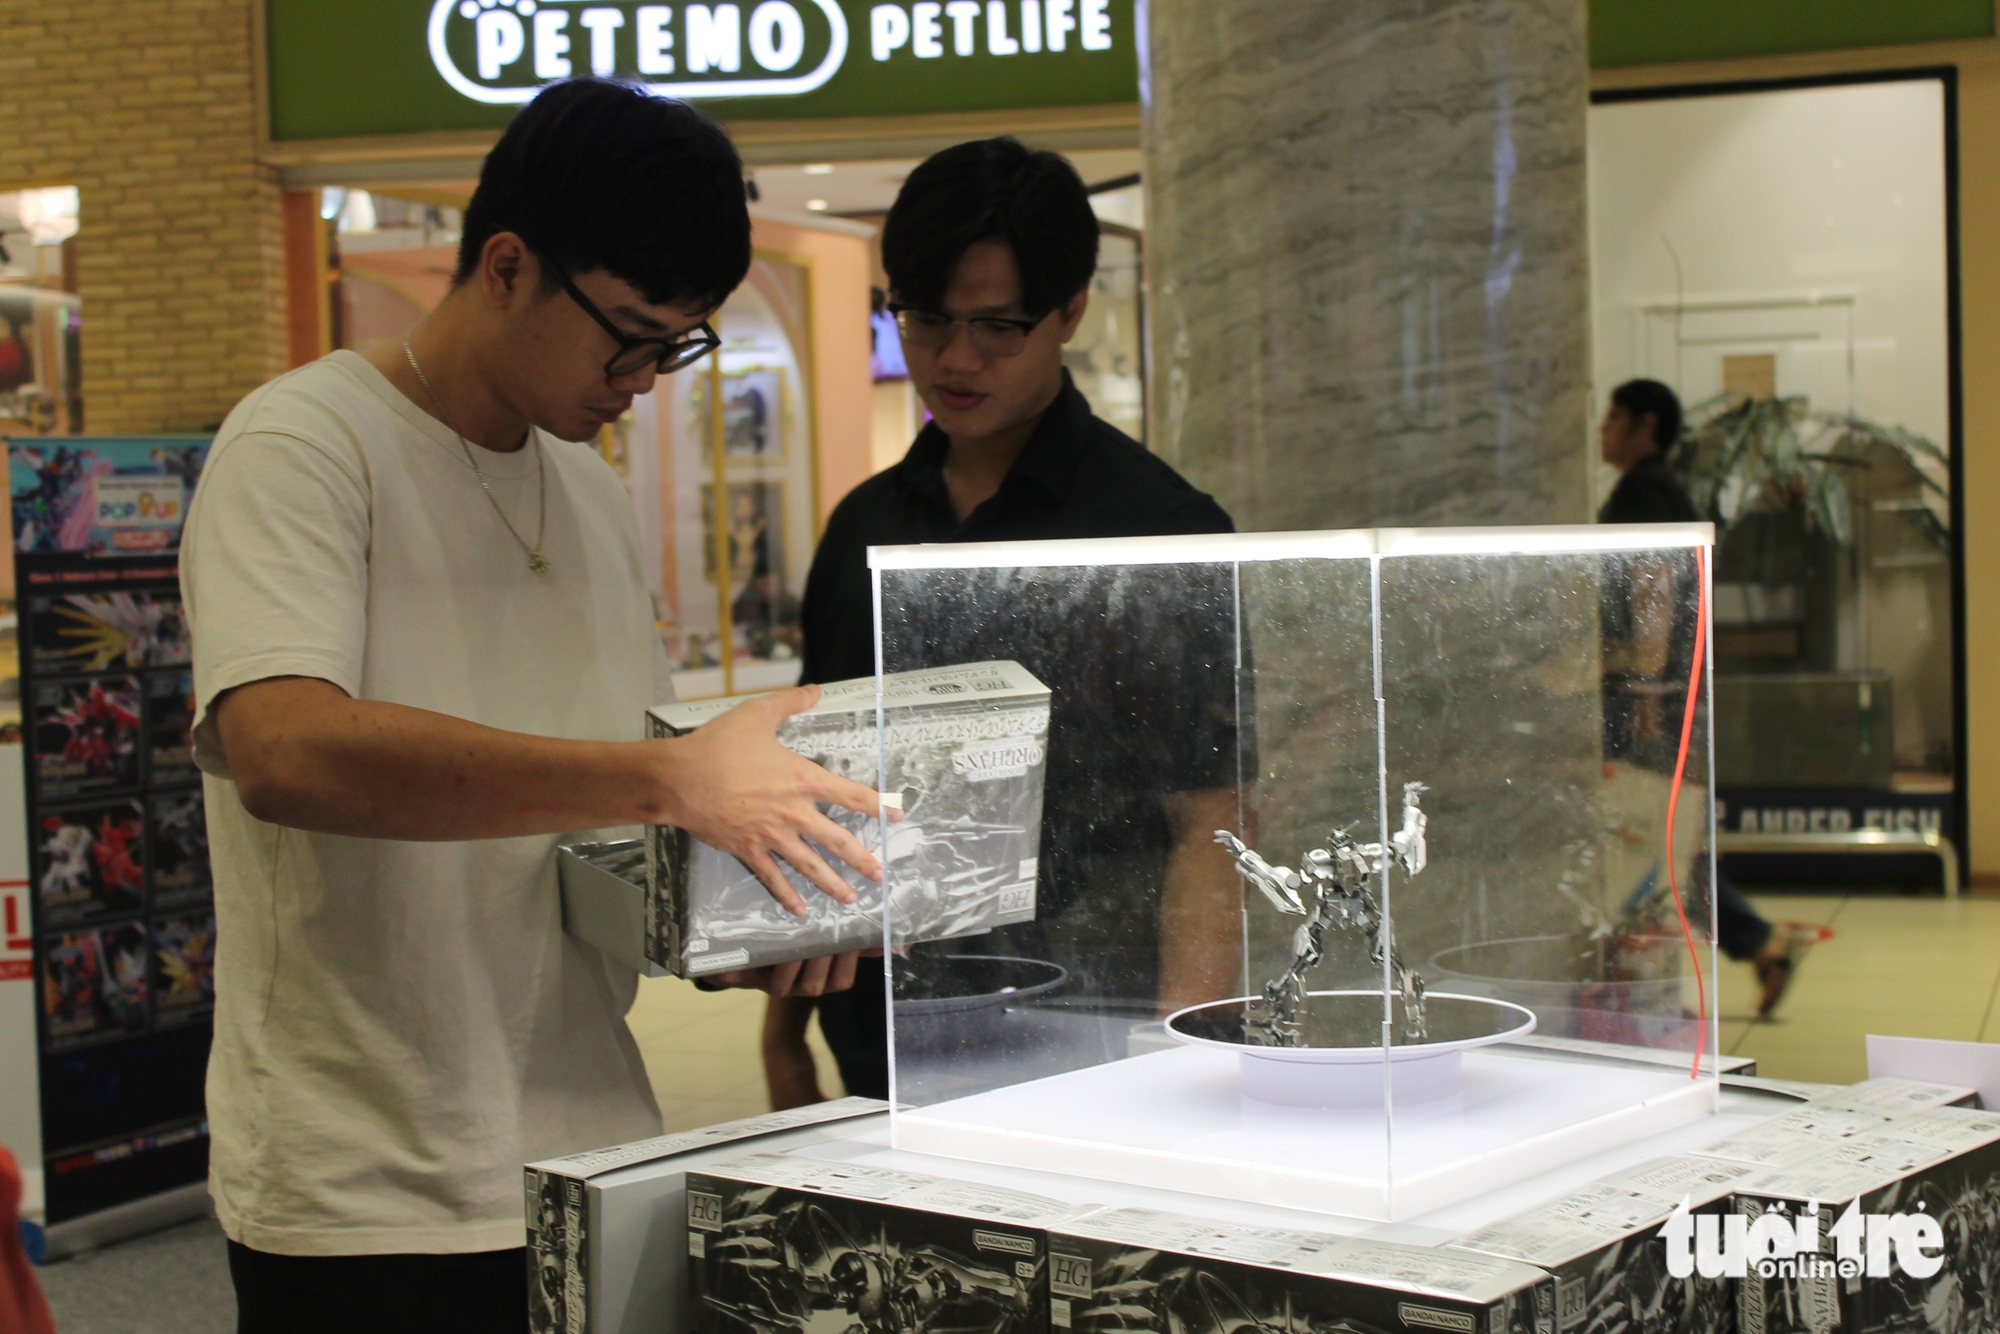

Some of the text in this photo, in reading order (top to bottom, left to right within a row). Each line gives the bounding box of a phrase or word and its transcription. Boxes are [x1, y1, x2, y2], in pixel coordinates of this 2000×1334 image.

[476, 0, 1113, 80] PETEMO PETLIFE
[953, 747, 1042, 774] ORPHANS
[1001, 889, 1031, 910] HG
[690, 1196, 719, 1221] HG
[977, 1234, 1032, 1250] BANDAI NAMCO
[1017, 1263, 1032, 1274] 8+
[1053, 1258, 1088, 1287] HG
[1562, 1284, 1584, 1317] HG
[1404, 1308, 1469, 1327] BANDAI NAMCO
